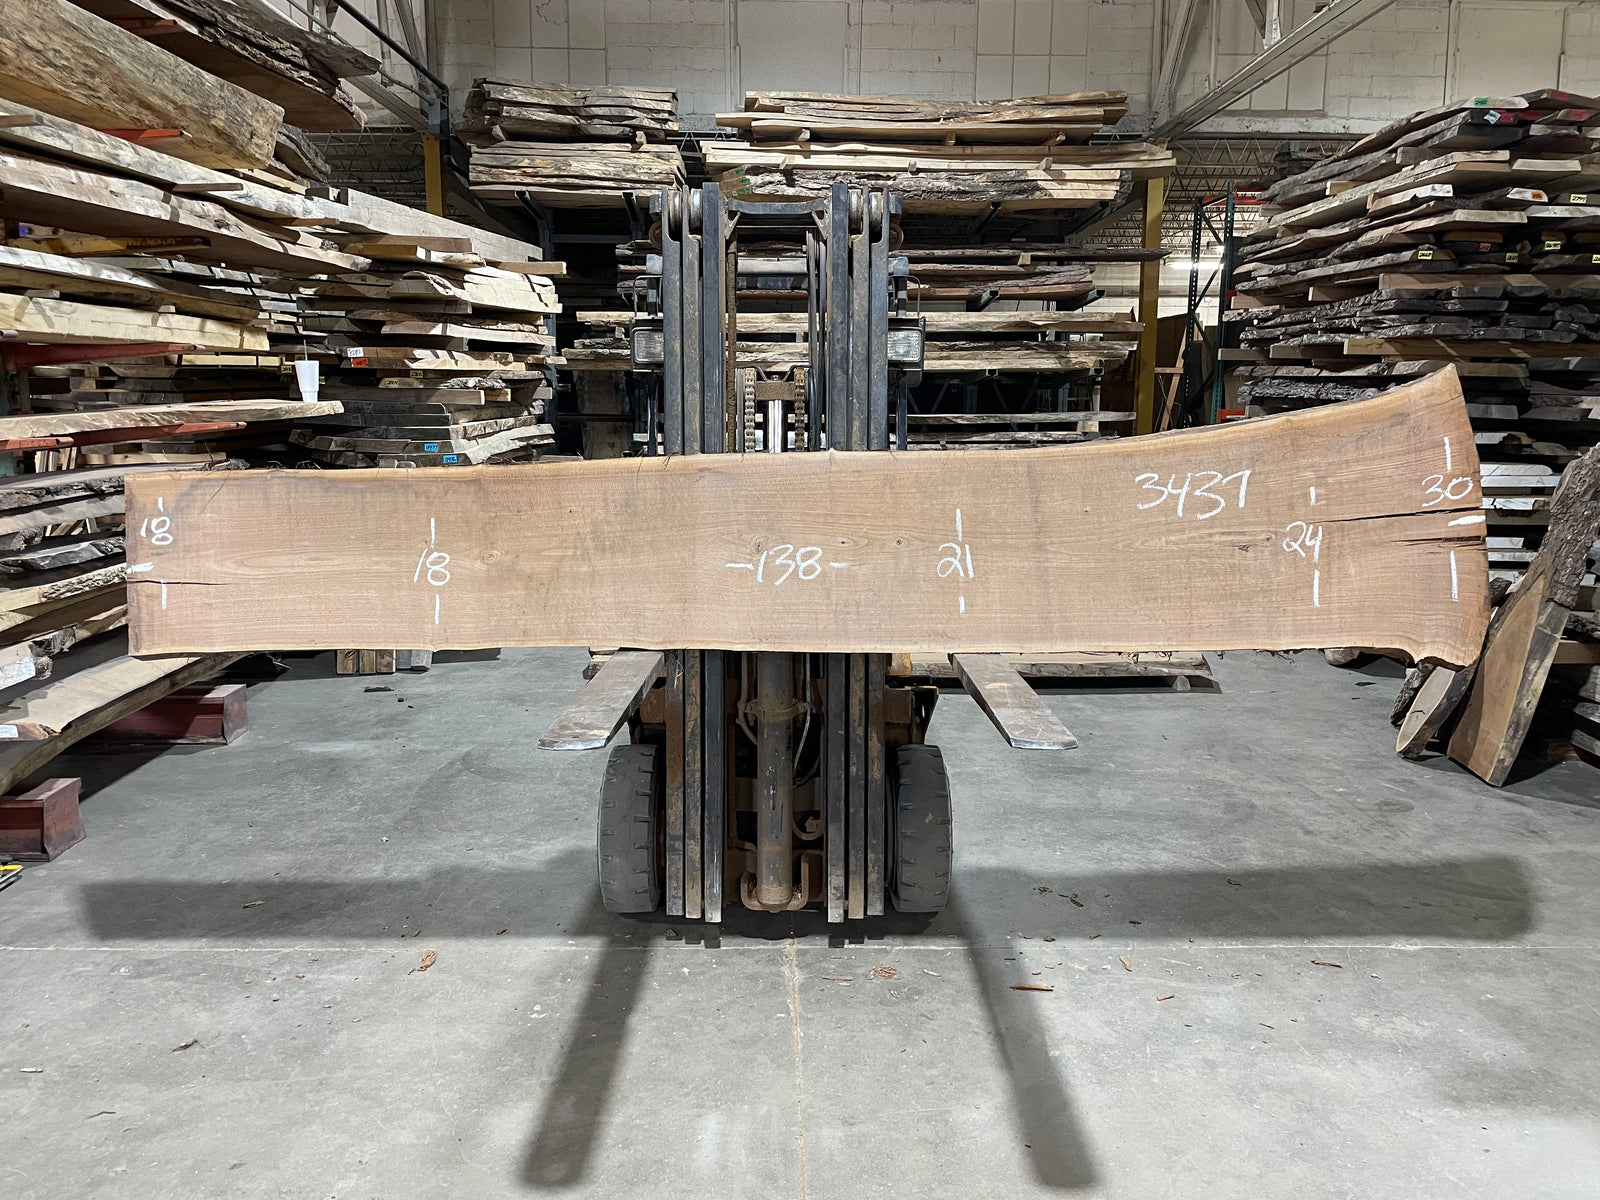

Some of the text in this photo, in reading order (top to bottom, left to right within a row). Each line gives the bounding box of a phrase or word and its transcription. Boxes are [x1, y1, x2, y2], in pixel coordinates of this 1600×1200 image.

[1135, 469, 1252, 520] 3437
[1421, 474, 1474, 507] 30
[140, 516, 173, 545] 18
[1282, 520, 1323, 563] 24
[413, 548, 450, 586] 18
[936, 542, 974, 579] 21
